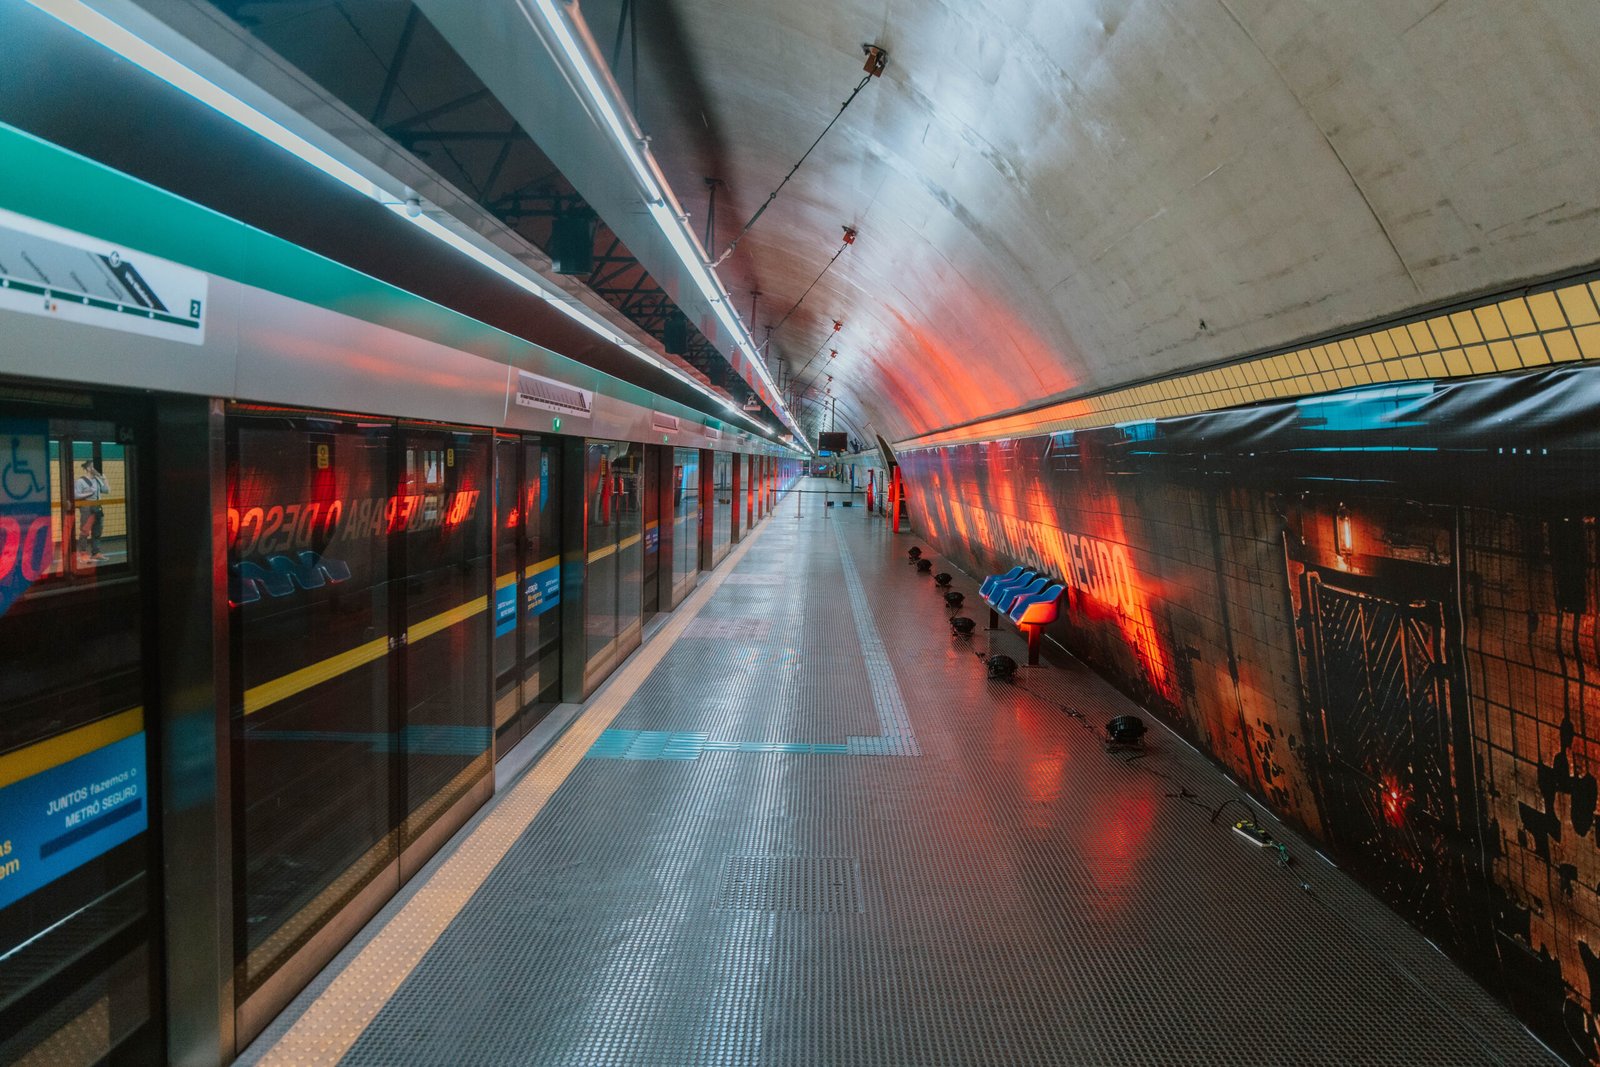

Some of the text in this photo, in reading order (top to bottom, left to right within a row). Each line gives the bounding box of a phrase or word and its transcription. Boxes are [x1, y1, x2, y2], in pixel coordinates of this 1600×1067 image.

[191, 302, 199, 316] 2
[1011, 518, 1135, 616] DESCONHECIDO
[46, 787, 88, 816] JUNTOS
[91, 773, 129, 795] fazemos
[66, 785, 138, 827] METRÔ SEGURO
